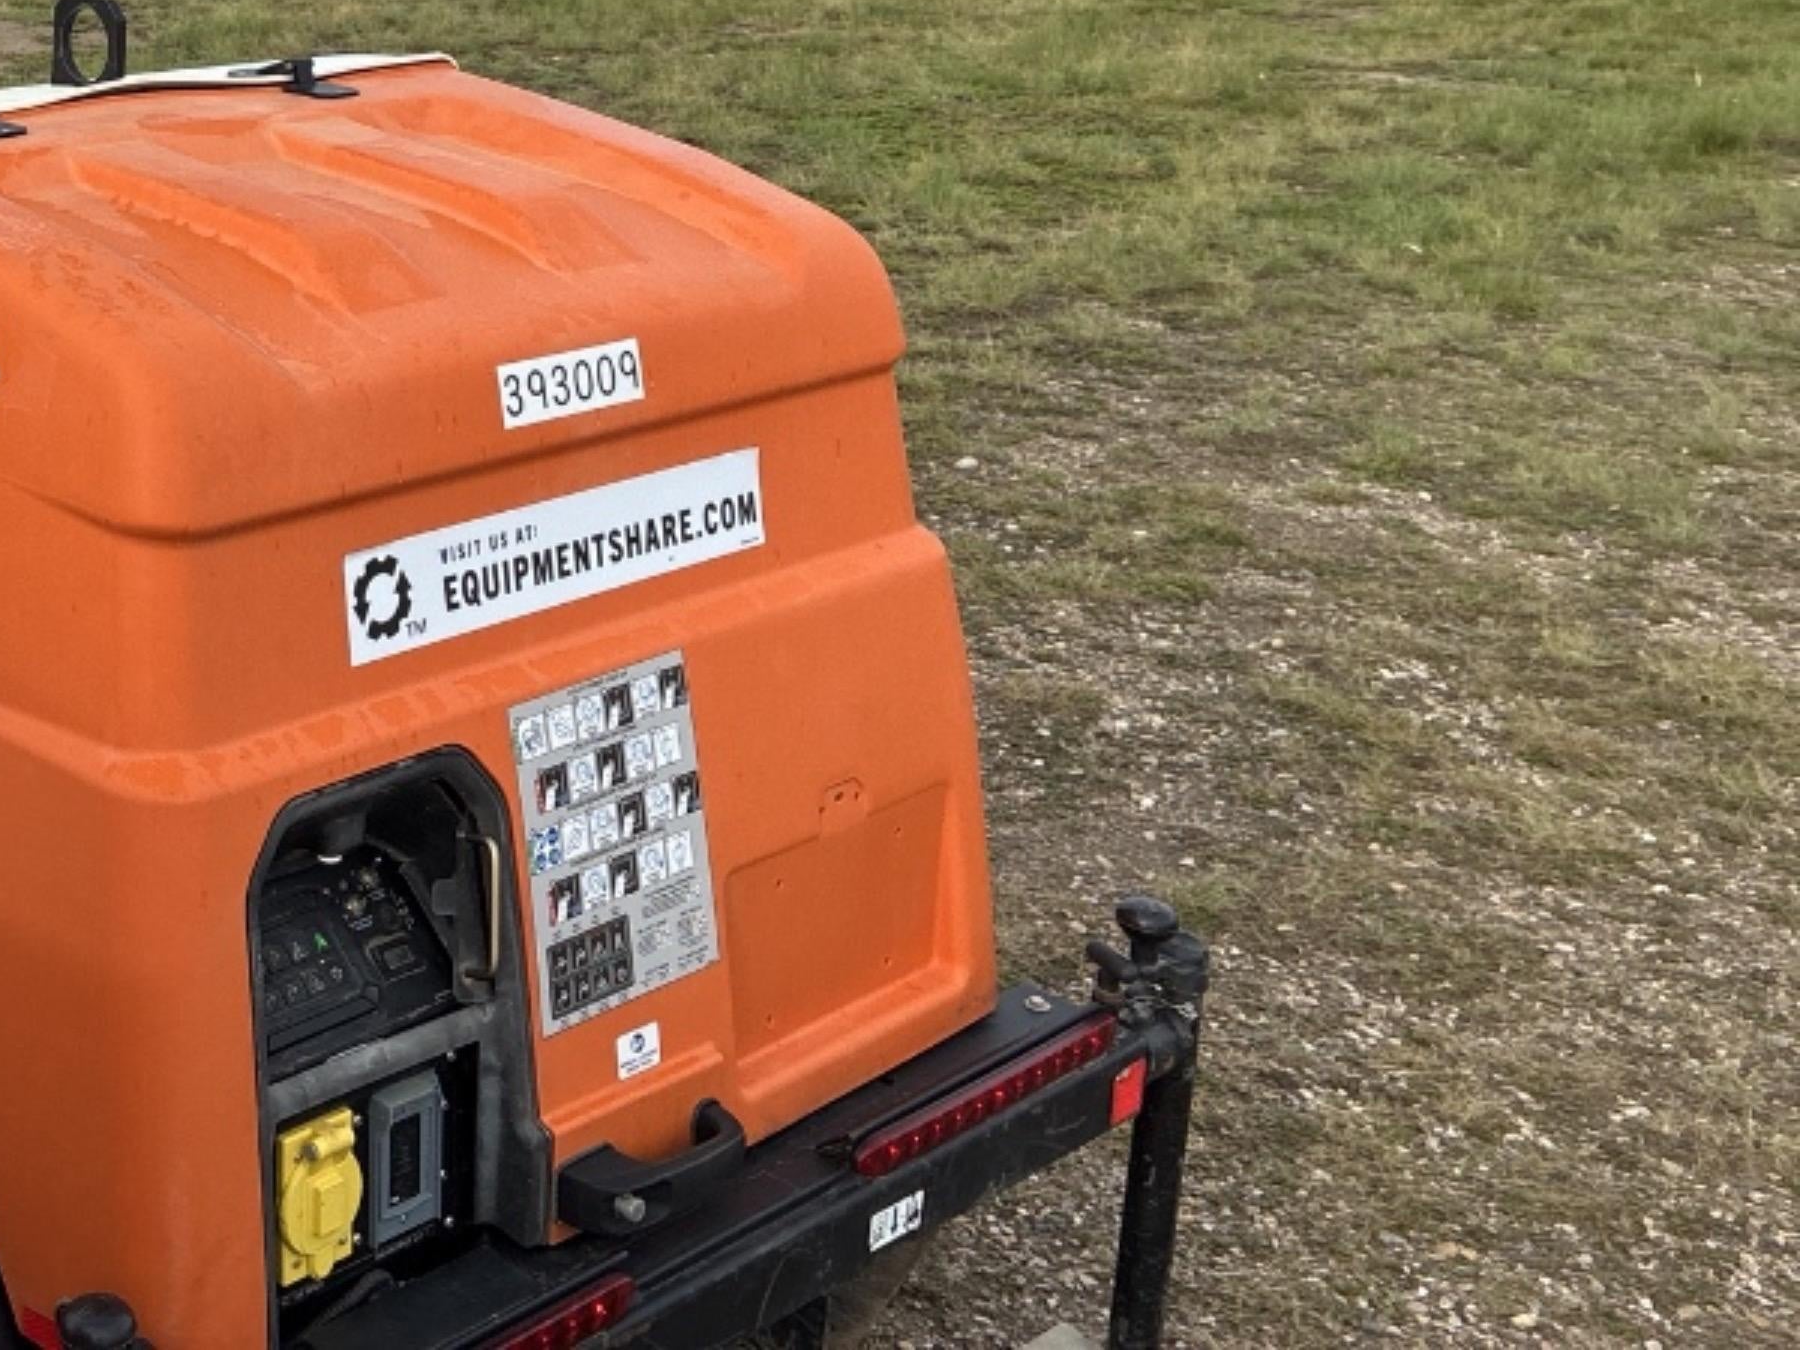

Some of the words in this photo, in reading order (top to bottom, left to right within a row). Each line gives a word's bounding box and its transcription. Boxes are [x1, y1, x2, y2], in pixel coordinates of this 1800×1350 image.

[503, 349, 640, 418] 393009
[440, 538, 481, 565] VISIT
[488, 530, 508, 553] US
[515, 523, 538, 546] AT:
[443, 491, 759, 613] EQUIPMENTSHARE.COM
